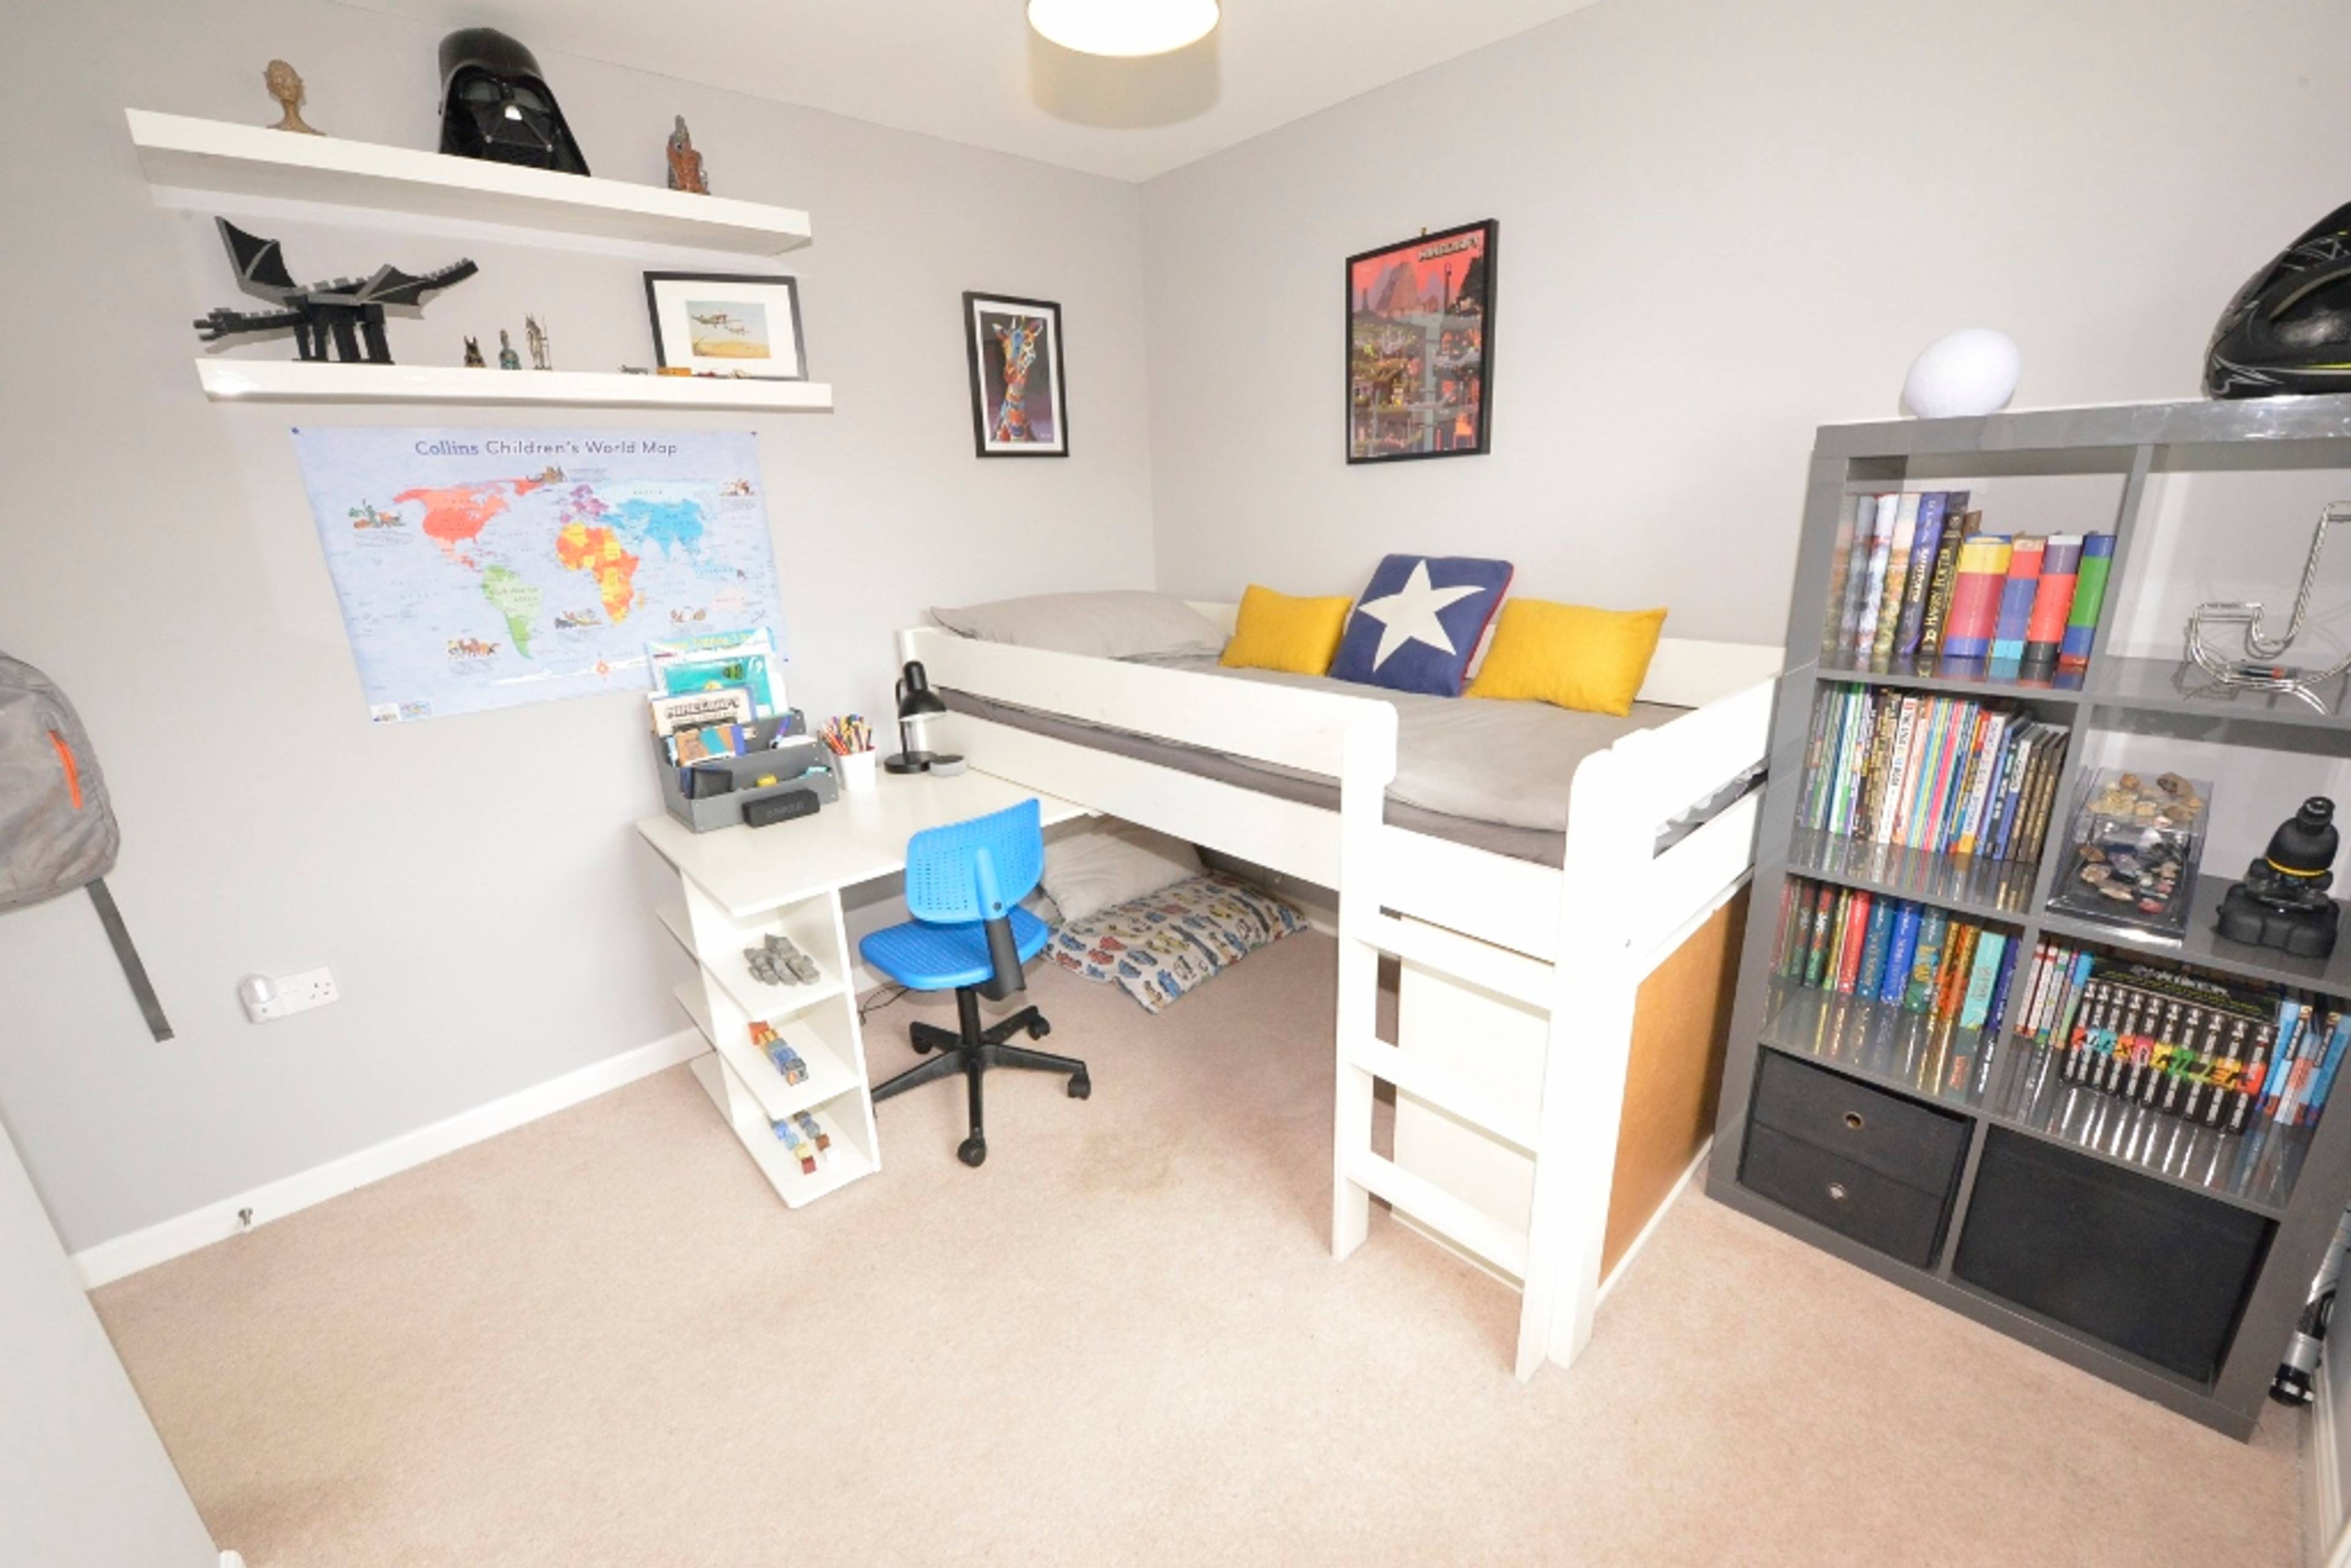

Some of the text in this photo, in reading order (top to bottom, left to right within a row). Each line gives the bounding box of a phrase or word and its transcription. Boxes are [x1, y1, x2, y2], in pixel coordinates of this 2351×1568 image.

[414, 440, 678, 457] Collins Children's World Map
